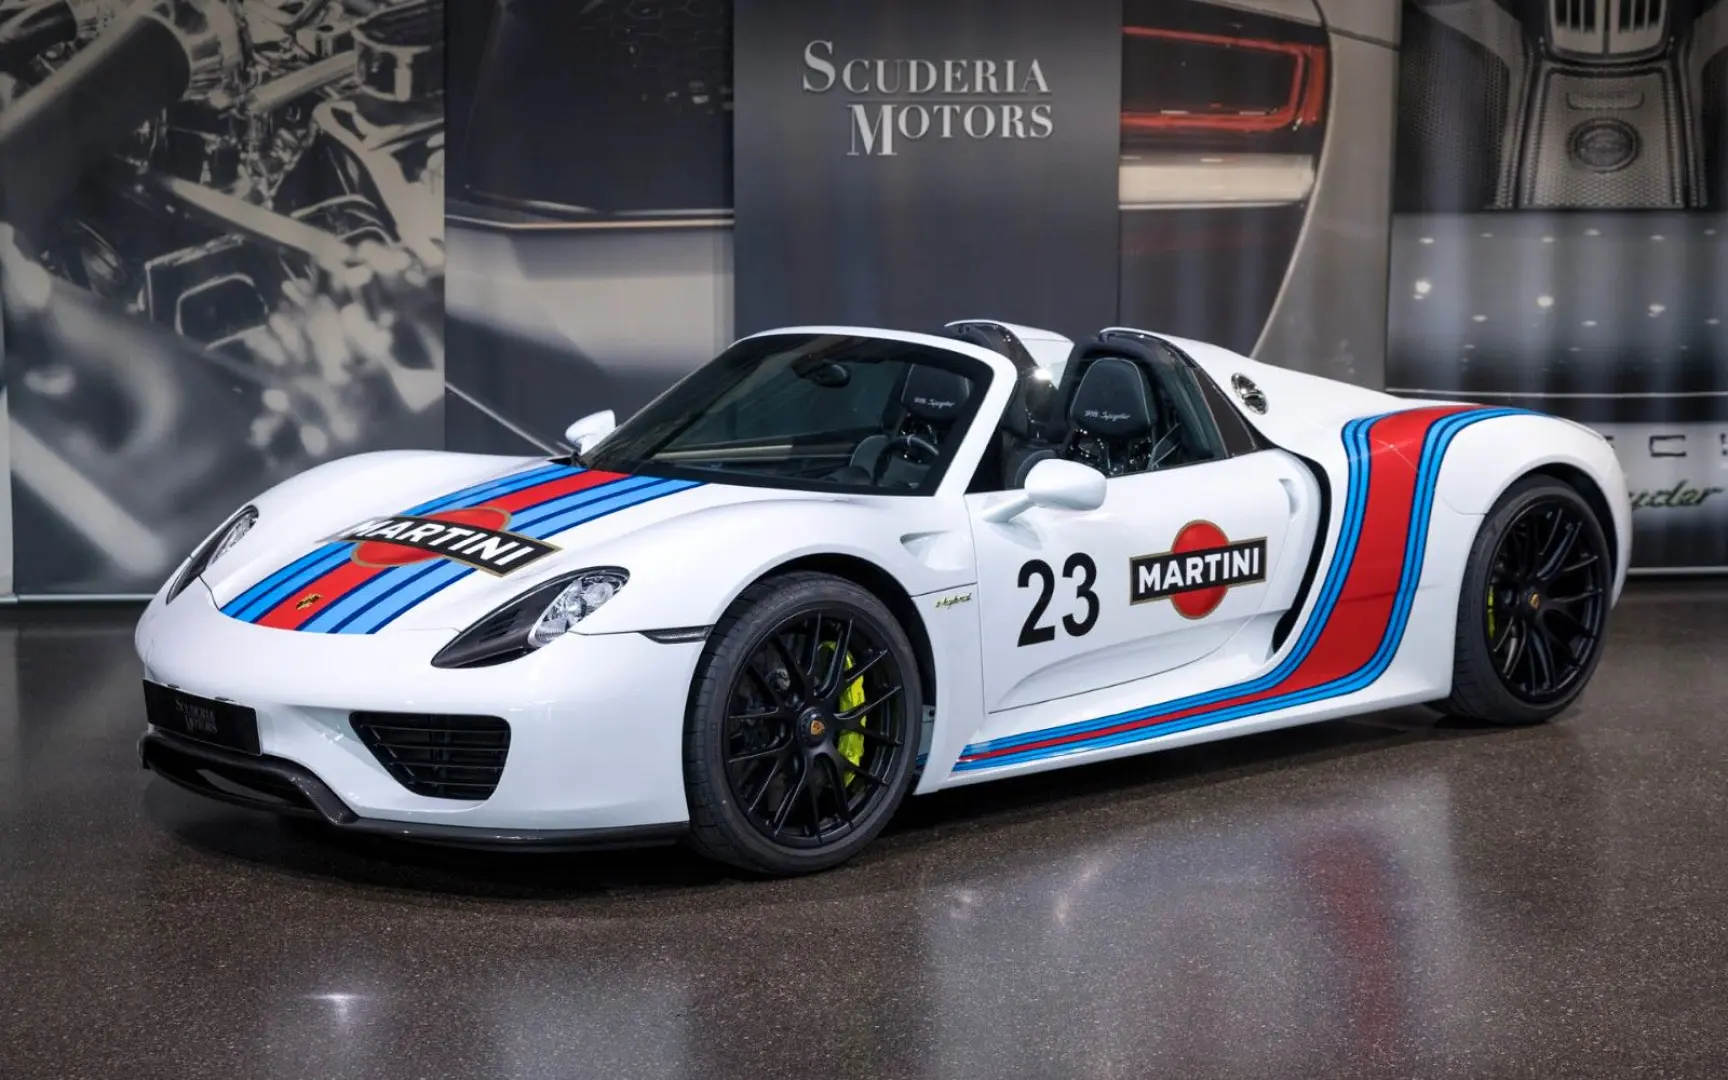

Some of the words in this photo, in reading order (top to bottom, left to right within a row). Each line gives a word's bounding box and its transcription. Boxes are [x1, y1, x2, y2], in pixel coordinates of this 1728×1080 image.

[802, 39, 1052, 94] SCUDERIA
[847, 103, 1054, 156] MOTORS
[1628, 479, 1724, 511] yder
[340, 518, 536, 567] MARTINI
[1137, 546, 1260, 595] MARTINI
[1016, 551, 1101, 648] 23
